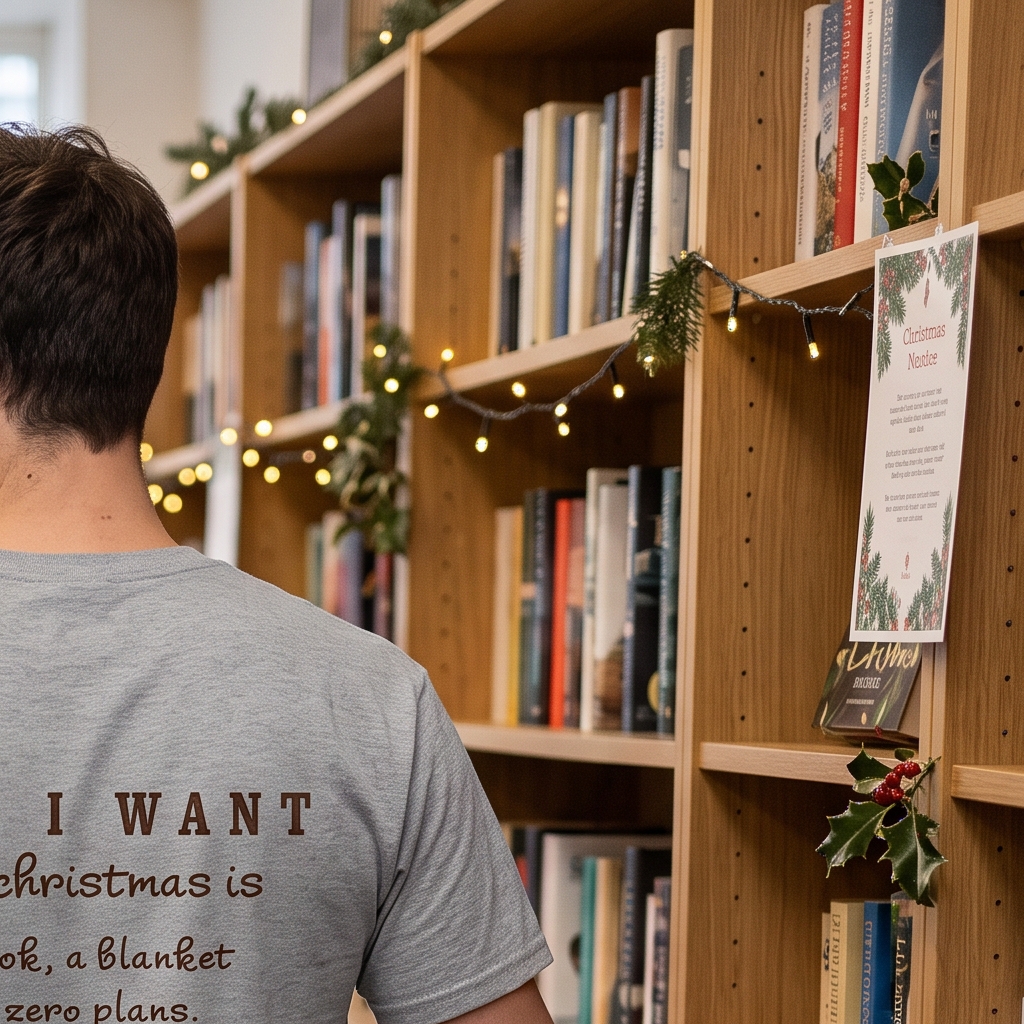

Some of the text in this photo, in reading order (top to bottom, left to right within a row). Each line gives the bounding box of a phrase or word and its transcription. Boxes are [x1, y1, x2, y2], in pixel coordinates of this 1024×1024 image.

[902, 324, 946, 346] Christmas
[46, 791, 63, 836] I
[114, 791, 311, 836] WANT
[226, 865, 264, 898] is
[66, 951, 88, 970] a
[97, 935, 236, 973] blanket
[4, 1003, 81, 1023] zero
